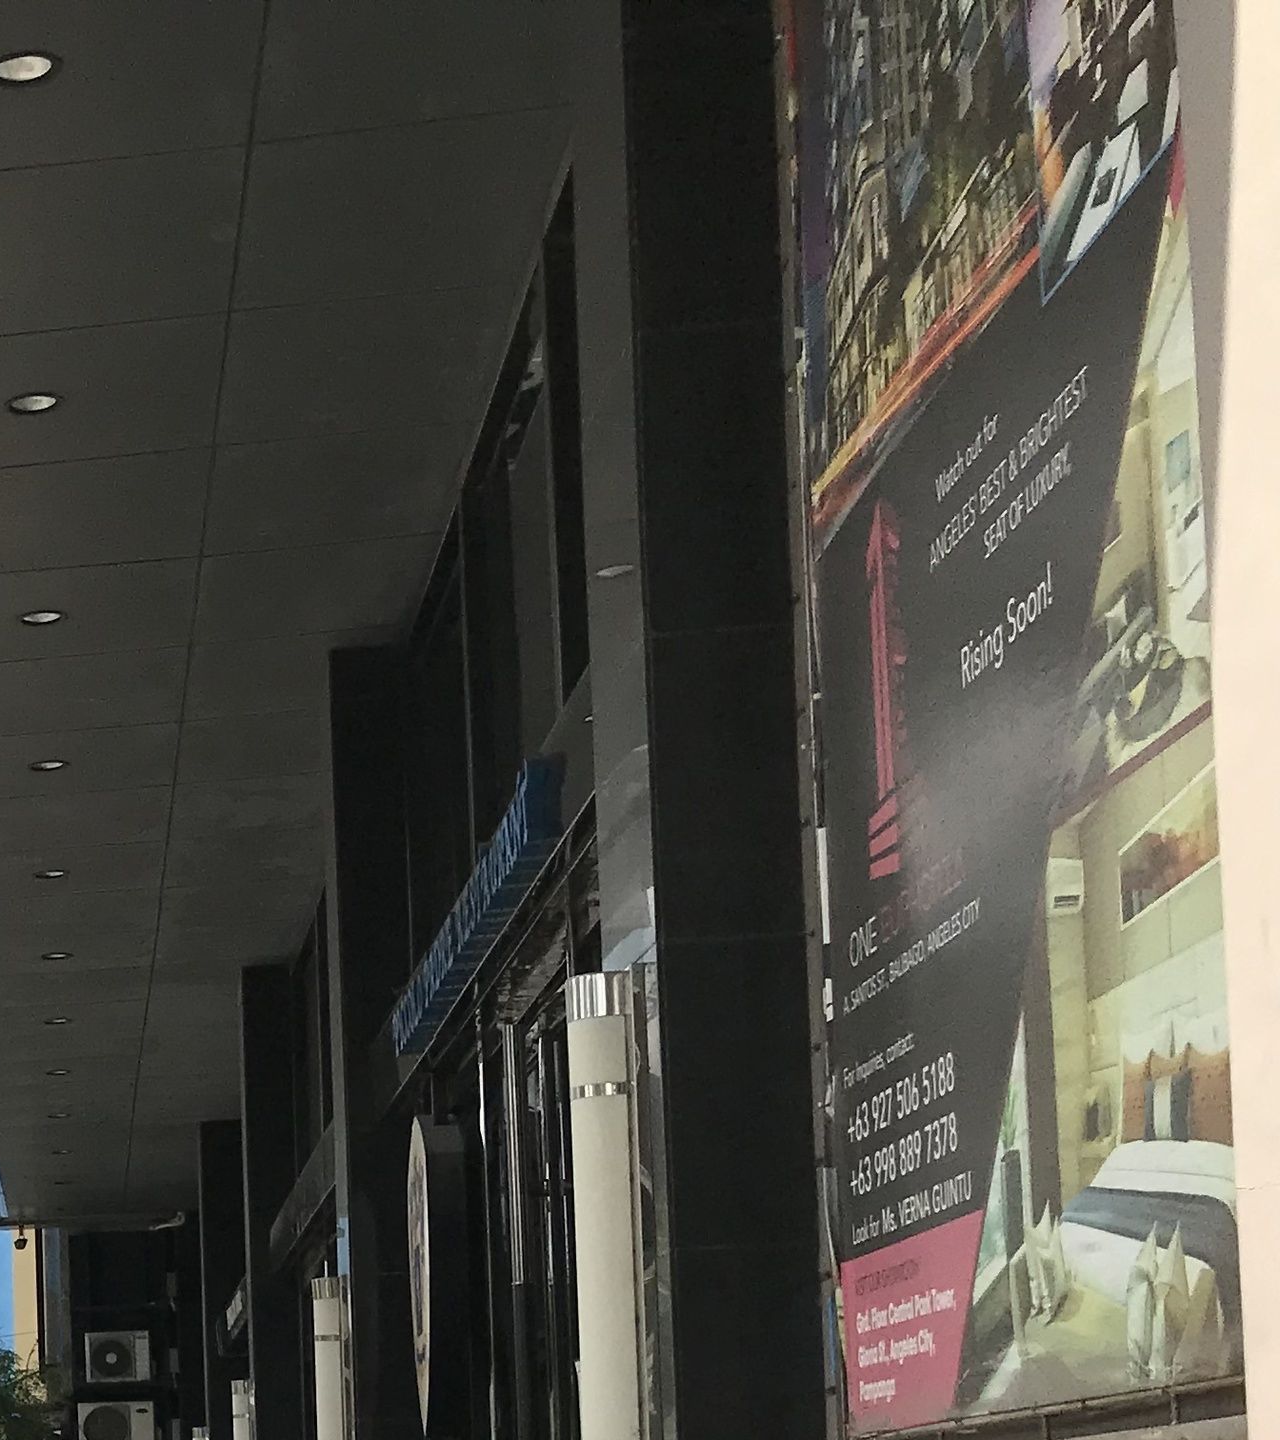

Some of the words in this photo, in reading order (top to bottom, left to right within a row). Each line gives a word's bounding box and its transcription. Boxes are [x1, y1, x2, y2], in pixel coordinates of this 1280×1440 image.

[935, 450, 965, 502] Watch
[965, 432, 982, 467] out
[983, 413, 999, 444] for
[978, 458, 1007, 515] BEST
[1008, 449, 1019, 481] &
[1019, 365, 1089, 470] BRIGHTEST
[983, 510, 1008, 560] SEAT
[1009, 492, 1024, 530] OF
[961, 624, 1004, 689] Rising
[1006, 560, 1053, 643] Soon!
[848, 915, 878, 968] ONE
[927, 911, 962, 956] ANGELES
[962, 896, 981, 930] CITY
[847, 1101, 870, 1143] +63
[871, 1087, 893, 1132] 927
[896, 1072, 919, 1120] 506
[922, 1052, 955, 1106] 5188
[850, 1156, 872, 1196] +63
[874, 1143, 897, 1187] 998
[899, 1130, 921, 1176] 889
[924, 1112, 958, 1163] 7378
[869, 1213, 880, 1238] for
[881, 1205, 898, 1234] Ms.
[898, 1189, 931, 1228] VERNA
